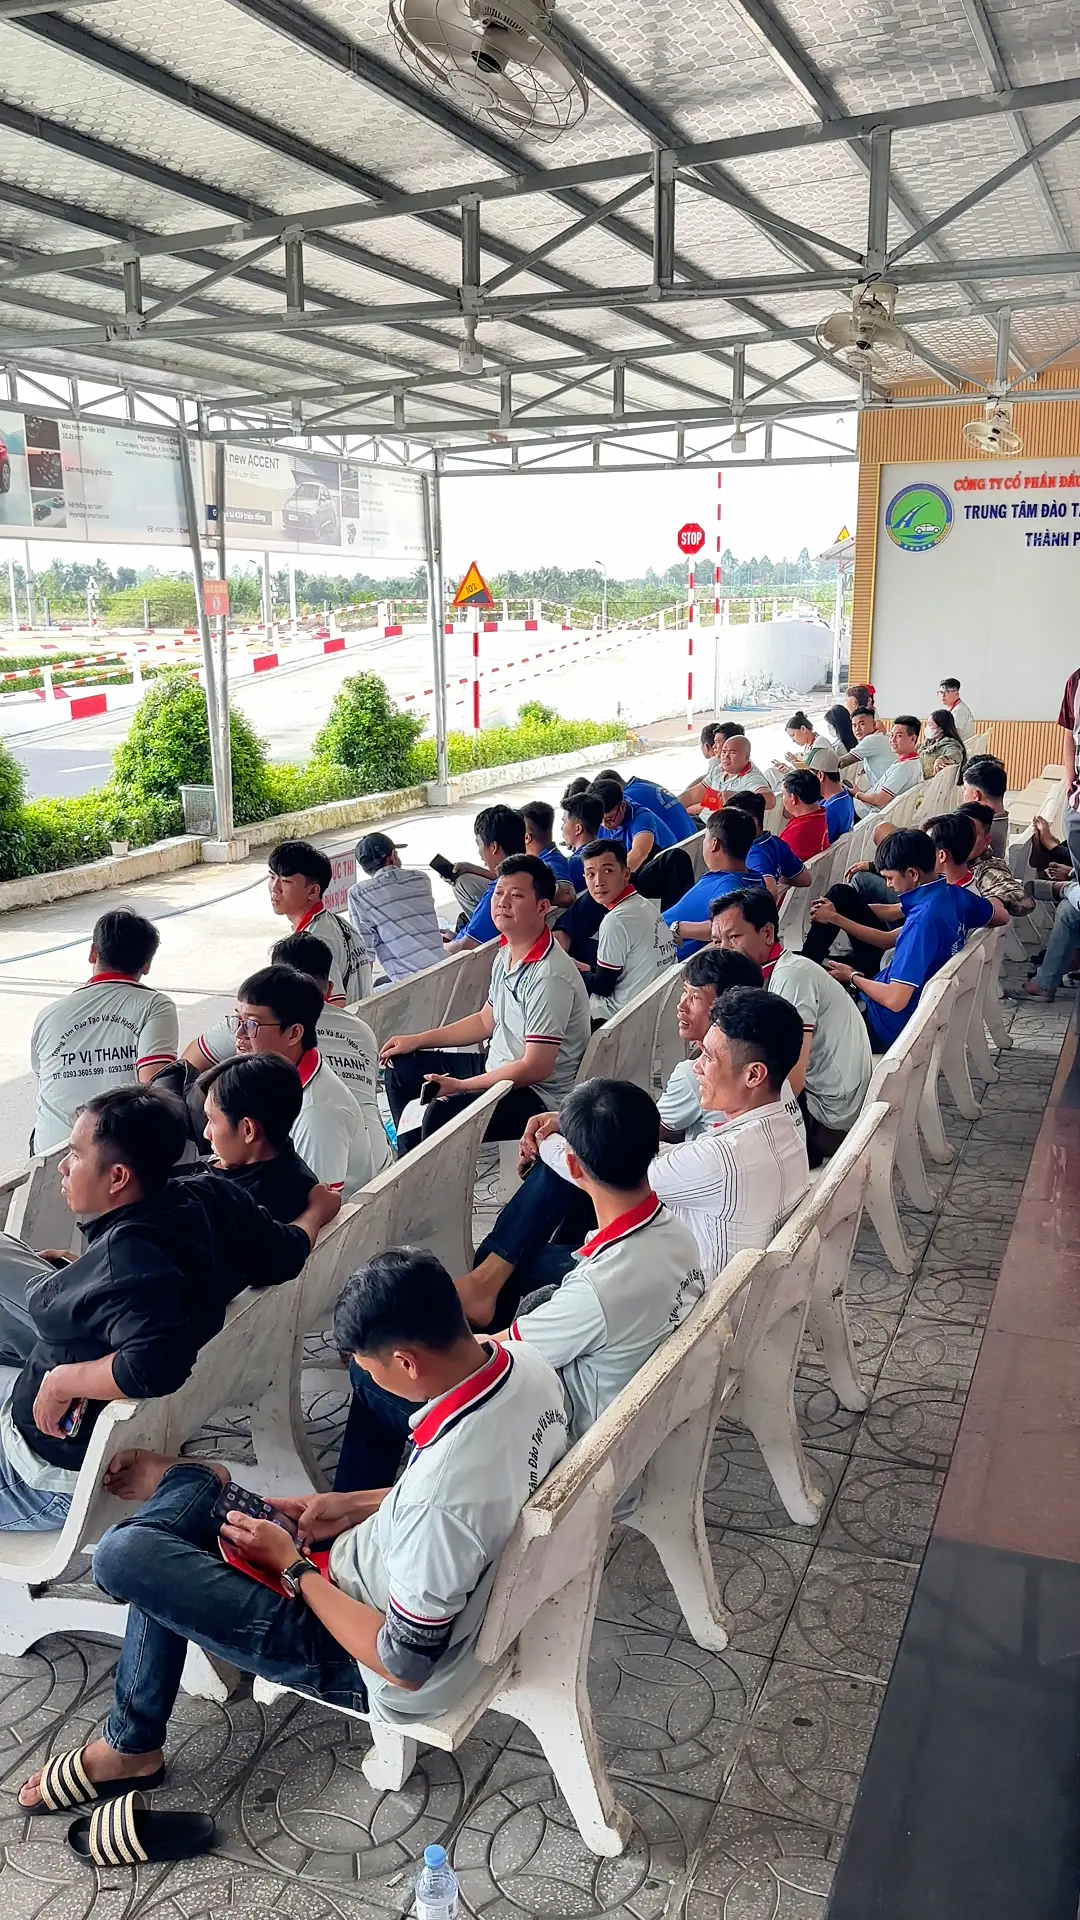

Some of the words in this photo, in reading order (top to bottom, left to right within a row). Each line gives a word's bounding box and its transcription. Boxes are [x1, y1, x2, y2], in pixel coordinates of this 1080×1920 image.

[229, 453, 247, 465] new
[248, 454, 280, 470] ACCENT
[954, 476, 986, 491] CÔNG
[989, 478, 1004, 490] TY
[964, 504, 1007, 519] TRUNG
[1011, 500, 1038, 519] TÂM
[1041, 500, 1067, 518] ĐÀO
[681, 531, 702, 546] STOP
[1025, 529, 1069, 547] THÀNH
[343, 860, 354, 880] THI
[61, 1053, 76, 1066] TP
[79, 1050, 92, 1067] VỊ
[95, 1045, 137, 1062] THANH
[326, 1055, 366, 1072] THANH
[532, 1427, 543, 1446] Tạo
[528, 1446, 539, 1469] Đào
